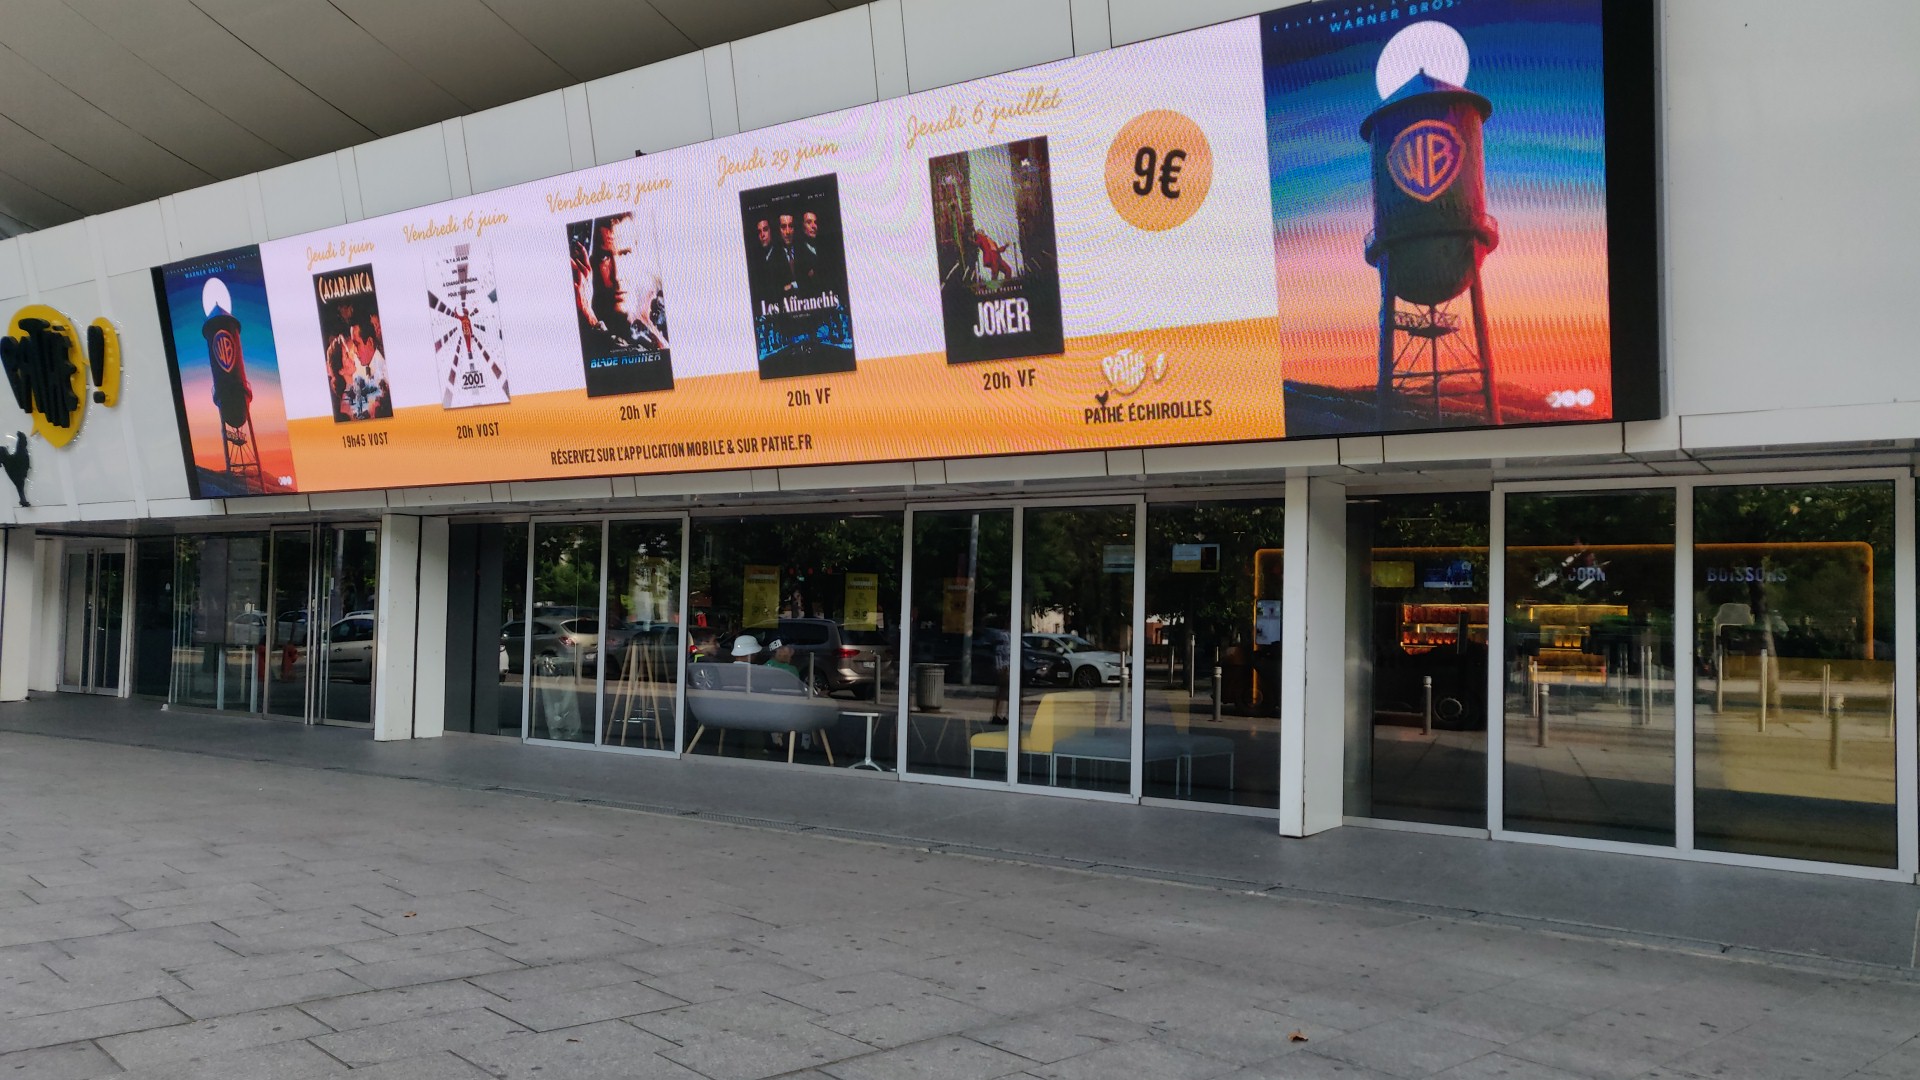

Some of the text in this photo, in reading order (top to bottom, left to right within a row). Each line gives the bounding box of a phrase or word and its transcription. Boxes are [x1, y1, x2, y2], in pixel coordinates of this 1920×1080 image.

[1329, 8, 1400, 33] WARNER
[907, 85, 1063, 149] Jeudi 6 juillet
[717, 138, 840, 187] Jeudi 29 juin
[1132, 146, 1186, 199] 9€
[546, 173, 672, 214] Vendredi 23 juin
[403, 209, 509, 243] Vendredi 16 juin
[307, 237, 375, 271] Jeudi 8 juin
[318, 272, 373, 304] CASABLANCA
[761, 290, 840, 316] Les Affranchis
[973, 297, 1031, 337] JOKER
[590, 352, 661, 369] BLADE RUNNER
[462, 373, 484, 386] 2001
[983, 369, 1036, 390] 20h VF
[787, 387, 831, 407] 20h VF
[620, 403, 657, 421] 20h VF
[1085, 400, 1212, 424] PATHÉ ÉCHIROLLES
[342, 432, 388, 449] 19h45 VOST
[456, 422, 500, 440] 20h VOST
[550, 434, 812, 465] RÉSERVEZ SUR L'APPLICATION MOBILE & SUR PATHE.FR
[1707, 566, 1788, 582] BOISSONS
